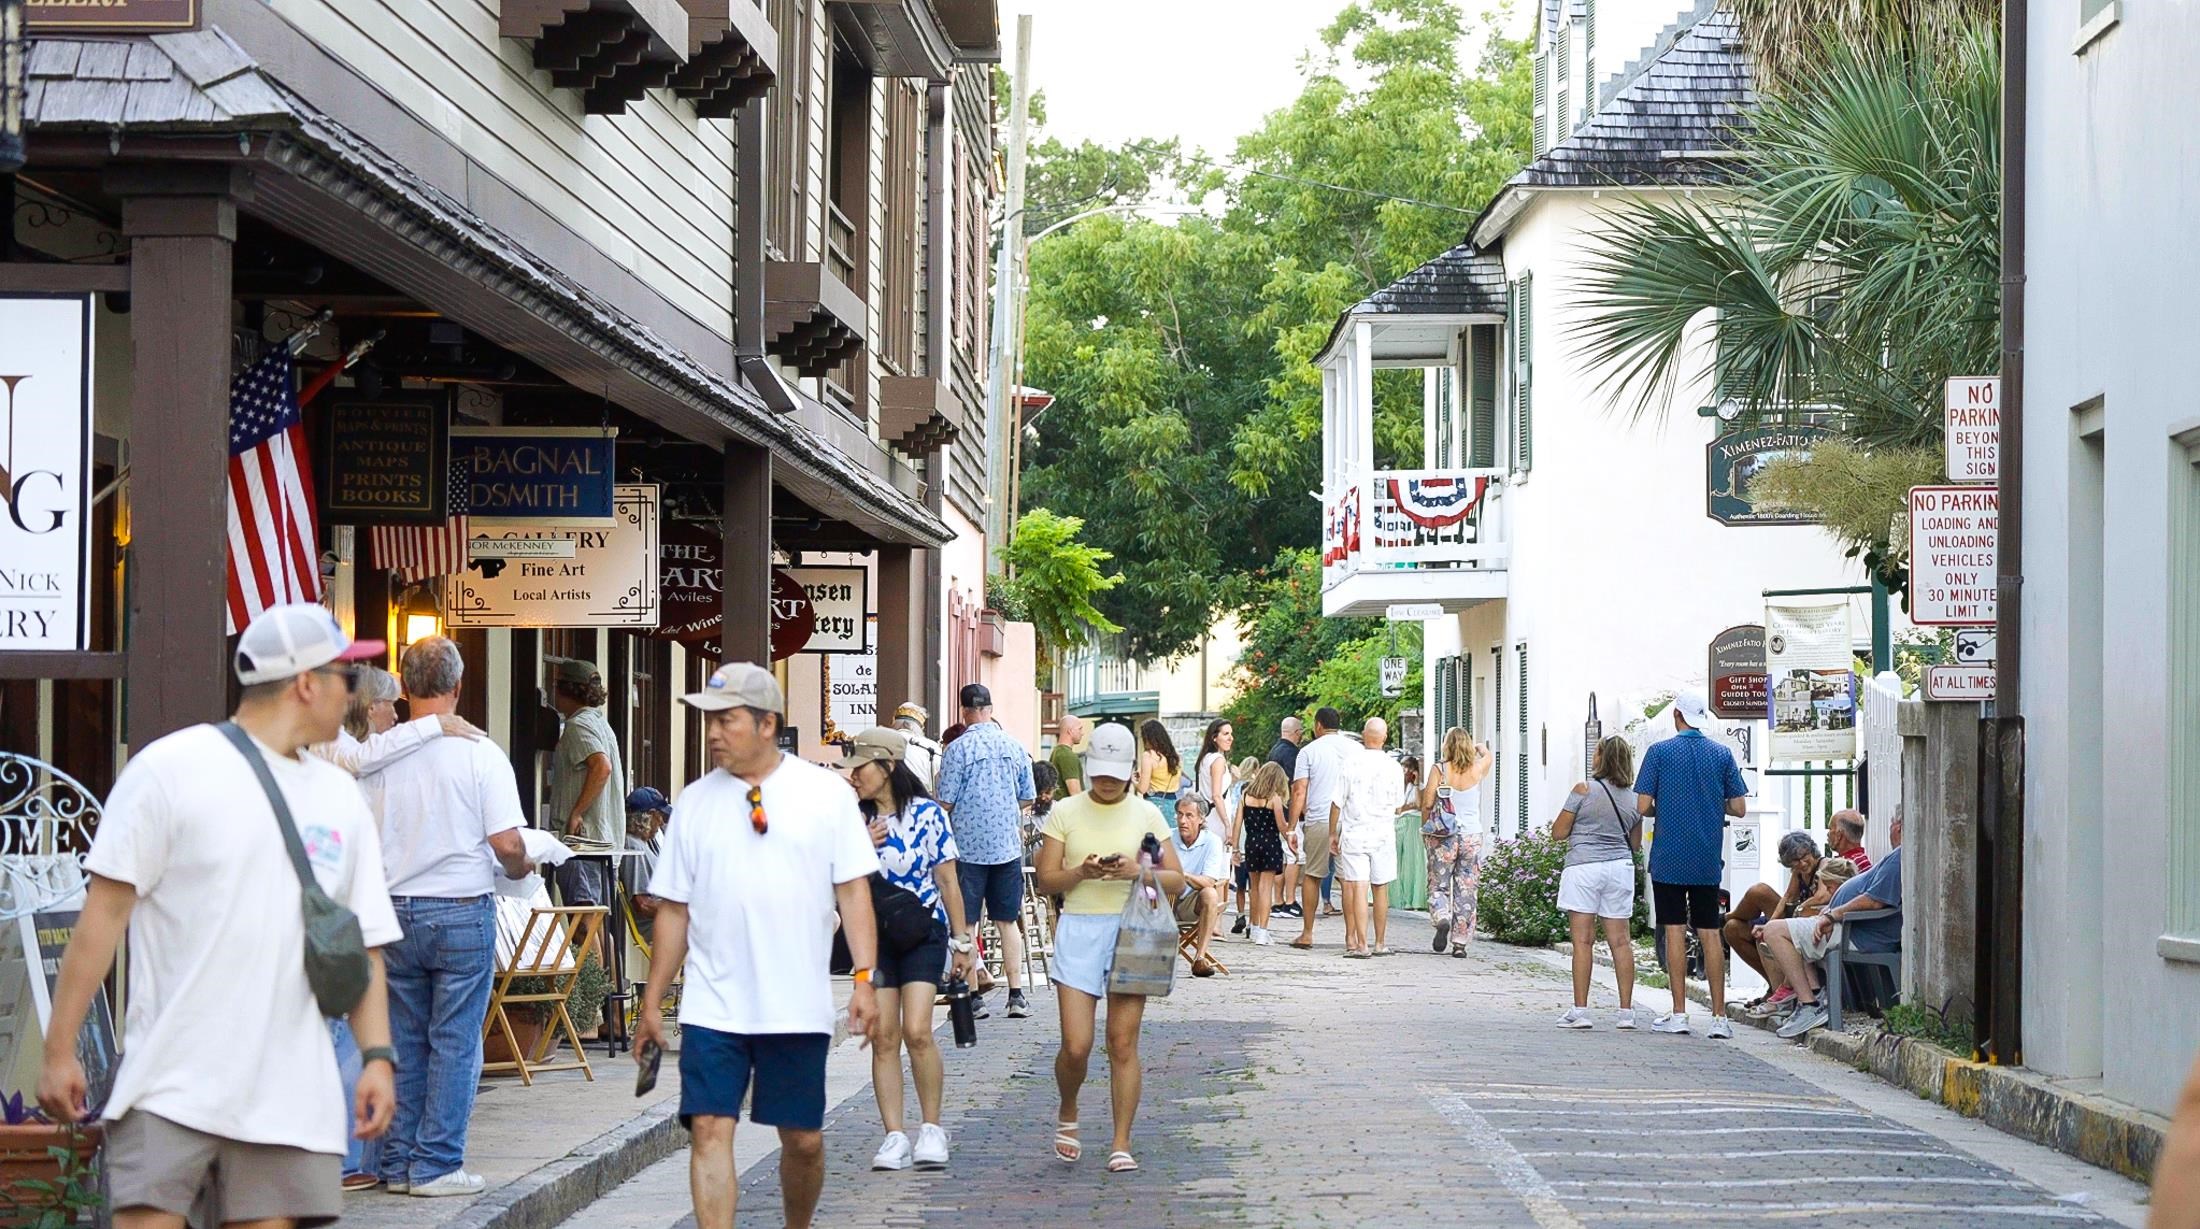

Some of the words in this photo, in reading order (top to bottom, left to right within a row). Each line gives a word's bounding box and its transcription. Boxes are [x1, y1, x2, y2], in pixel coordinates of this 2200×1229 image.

[1968, 386, 1993, 404] NO
[1950, 408, 2000, 427] PARKIN
[1956, 432, 1999, 444] BEYON
[338, 440, 426, 453] ANTIQUE
[1967, 446, 1995, 459] THIS
[357, 456, 409, 468] MAPS
[474, 446, 601, 474] BAGNAL
[1966, 462, 1996, 475] SIGN
[343, 473, 421, 487] PRINTS
[342, 489, 420, 504] BOOKS
[471, 484, 578, 508] DSMITH
[1915, 494, 1935, 511] NO
[1941, 494, 1998, 511] PARKIN
[1922, 517, 1970, 530] LOADING
[1977, 517, 1999, 530] AND
[493, 541, 555, 550] McKENNEY
[1928, 535, 1994, 548] UNLOADING
[660, 545, 716, 562] THE
[1931, 554, 1993, 567] VEHICLES
[521, 562, 554, 577] Fine
[559, 562, 585, 577] Art
[1945, 573, 1978, 586] ONLY
[513, 589, 546, 601] Local
[550, 589, 591, 601] Artists
[667, 591, 713, 603] Aviles
[803, 583, 852, 602] nsen
[1928, 588, 1944, 602] 30
[1950, 588, 1997, 602] MINUTE
[1945, 605, 1978, 618] LIMIT
[813, 613, 854, 640] tery
[856, 664, 872, 676] de
[1384, 658, 1403, 669] ONE
[1384, 671, 1404, 680] WAY
[1729, 676, 1746, 684] GIFT
[1932, 676, 1944, 689] AT
[1947, 676, 1965, 689] ALL
[1968, 676, 1996, 689] TIMES
[850, 703, 878, 715] INN
